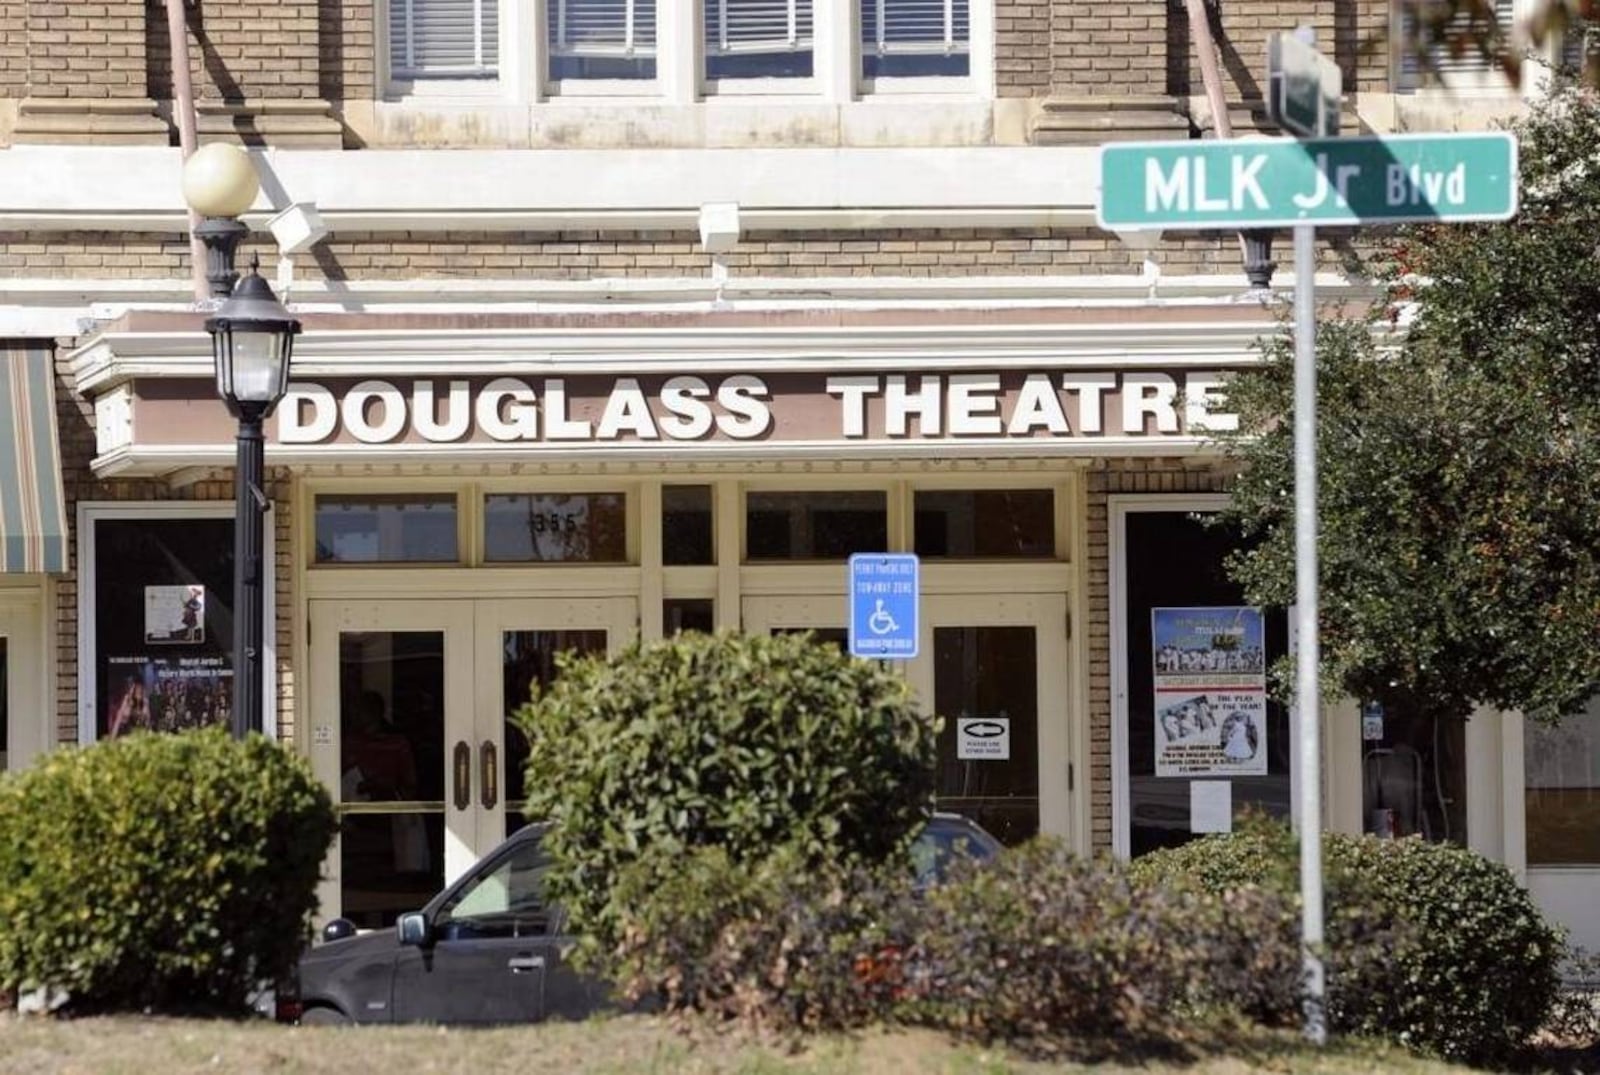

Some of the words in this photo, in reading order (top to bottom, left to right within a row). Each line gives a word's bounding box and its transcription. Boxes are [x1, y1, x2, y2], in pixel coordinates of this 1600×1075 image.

[1145, 154, 1271, 213] MLK
[1293, 153, 1360, 209] Jr
[1386, 161, 1466, 206] Blvd
[277, 374, 771, 443] DOUGLASS
[826, 371, 1239, 437] THEATRE
[535, 513, 577, 532] 355
